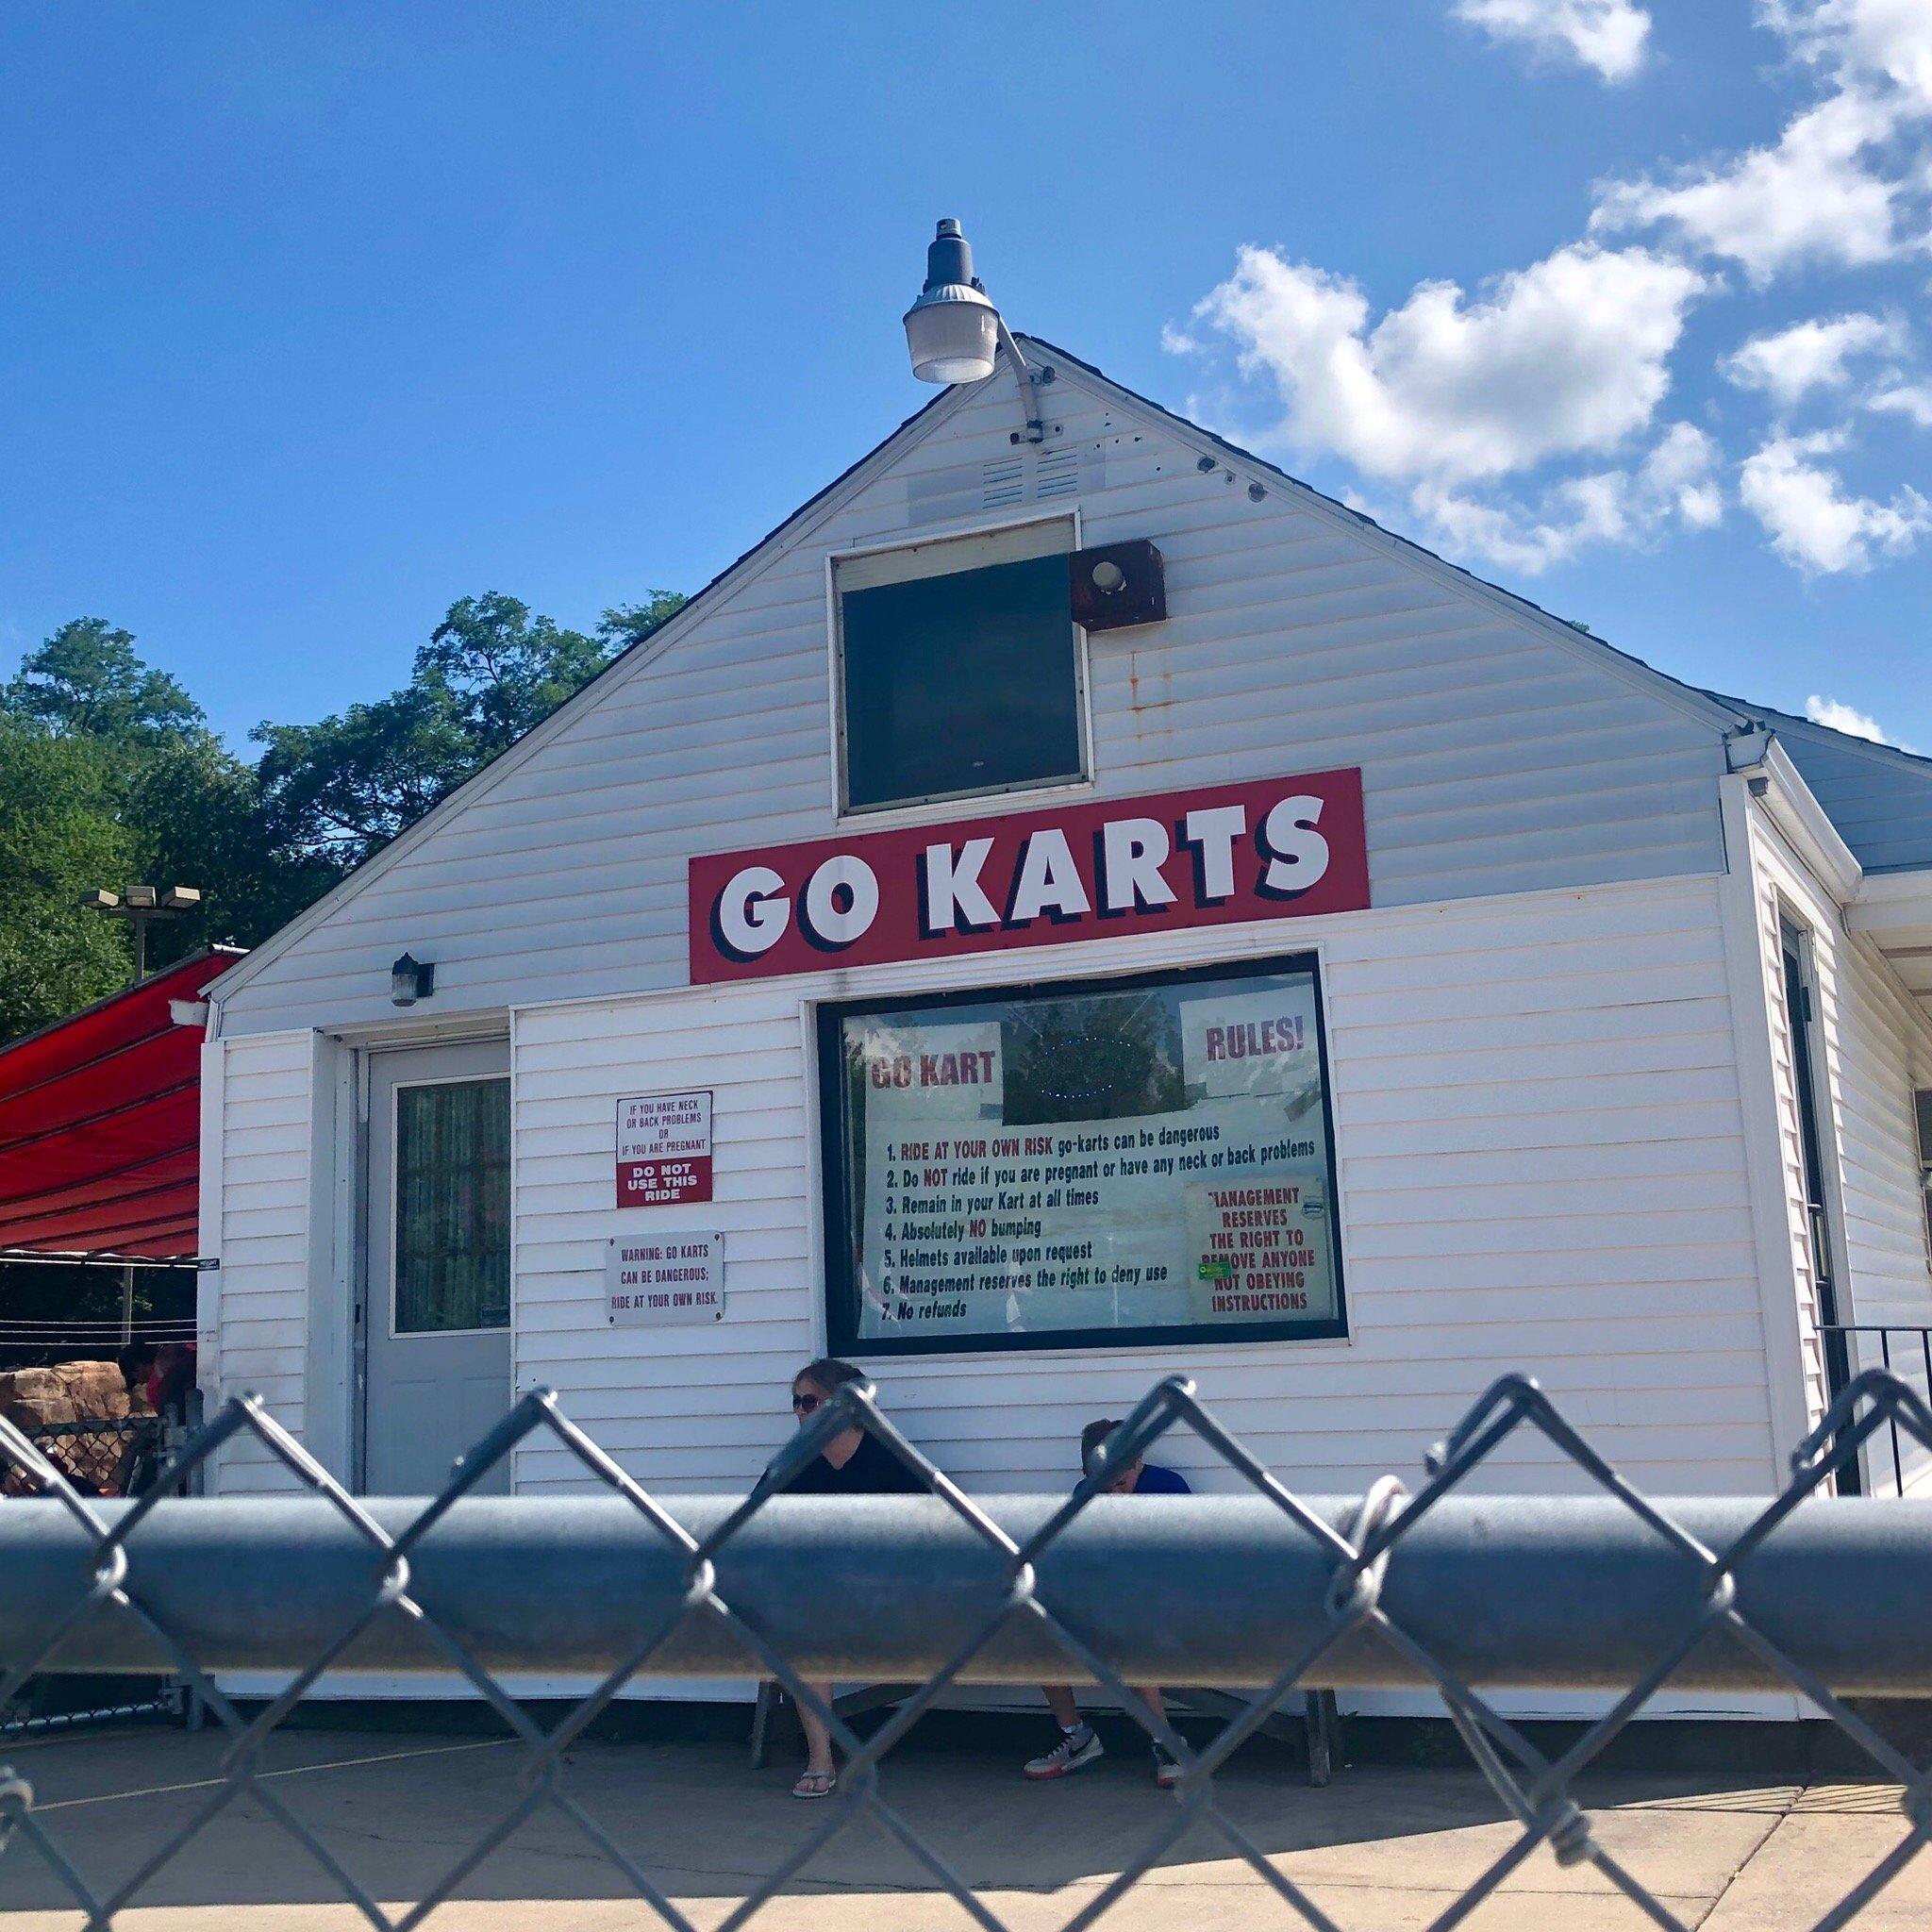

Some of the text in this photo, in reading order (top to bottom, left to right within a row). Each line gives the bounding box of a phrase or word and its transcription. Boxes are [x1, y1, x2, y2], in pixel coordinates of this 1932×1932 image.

[714, 794, 1331, 958] GO KARTS
[1207, 1016, 1304, 1061] RULES!
[872, 1051, 995, 1089] GO KART
[630, 1099, 699, 1115] IF YOU HAVE NECK
[626, 1112, 702, 1129] OR BACK PROBLEMS
[658, 1128, 669, 1140] OR
[888, 1125, 1220, 1161] 1. RIDE AT YOUR OWN RISK go-karts can be dangerous
[622, 1139, 707, 1157] IF YOU ARE PREGNANT
[633, 1163, 691, 1178] DO NOT
[887, 1139, 1315, 1189] 2. Do NOT ride if you are pregnant or have any neck or back problems
[627, 1174, 698, 1191] USE THIS
[644, 1189, 681, 1202] RIDE
[886, 1188, 1099, 1215] 3. Remain in your Kart at all times
[1223, 1209, 1288, 1228] RESERVES
[885, 1216, 1041, 1242] 4. Absolutely NO bumping
[1209, 1228, 1304, 1249] THE RIGHT TO
[621, 1243, 709, 1262] WARNING: GO KARTS
[884, 1241, 1092, 1268] 5. Helmets available upon request
[1261, 1249, 1315, 1268] ANYONE
[621, 1271, 638, 1285] CAN
[641, 1270, 652, 1283] BE
[883, 1264, 1168, 1297] 6. Management reserves the right to deny use
[1213, 1271, 1305, 1291] NOT OBEYING
[611, 1295, 630, 1309] RIDE
[633, 1294, 644, 1308] AT
[647, 1293, 670, 1308] YOUR
[673, 1292, 692, 1307] OWN
[897, 1302, 914, 1321] No
[918, 1300, 967, 1319] refunds
[1211, 1291, 1308, 1313] INSTRUCTIONS
